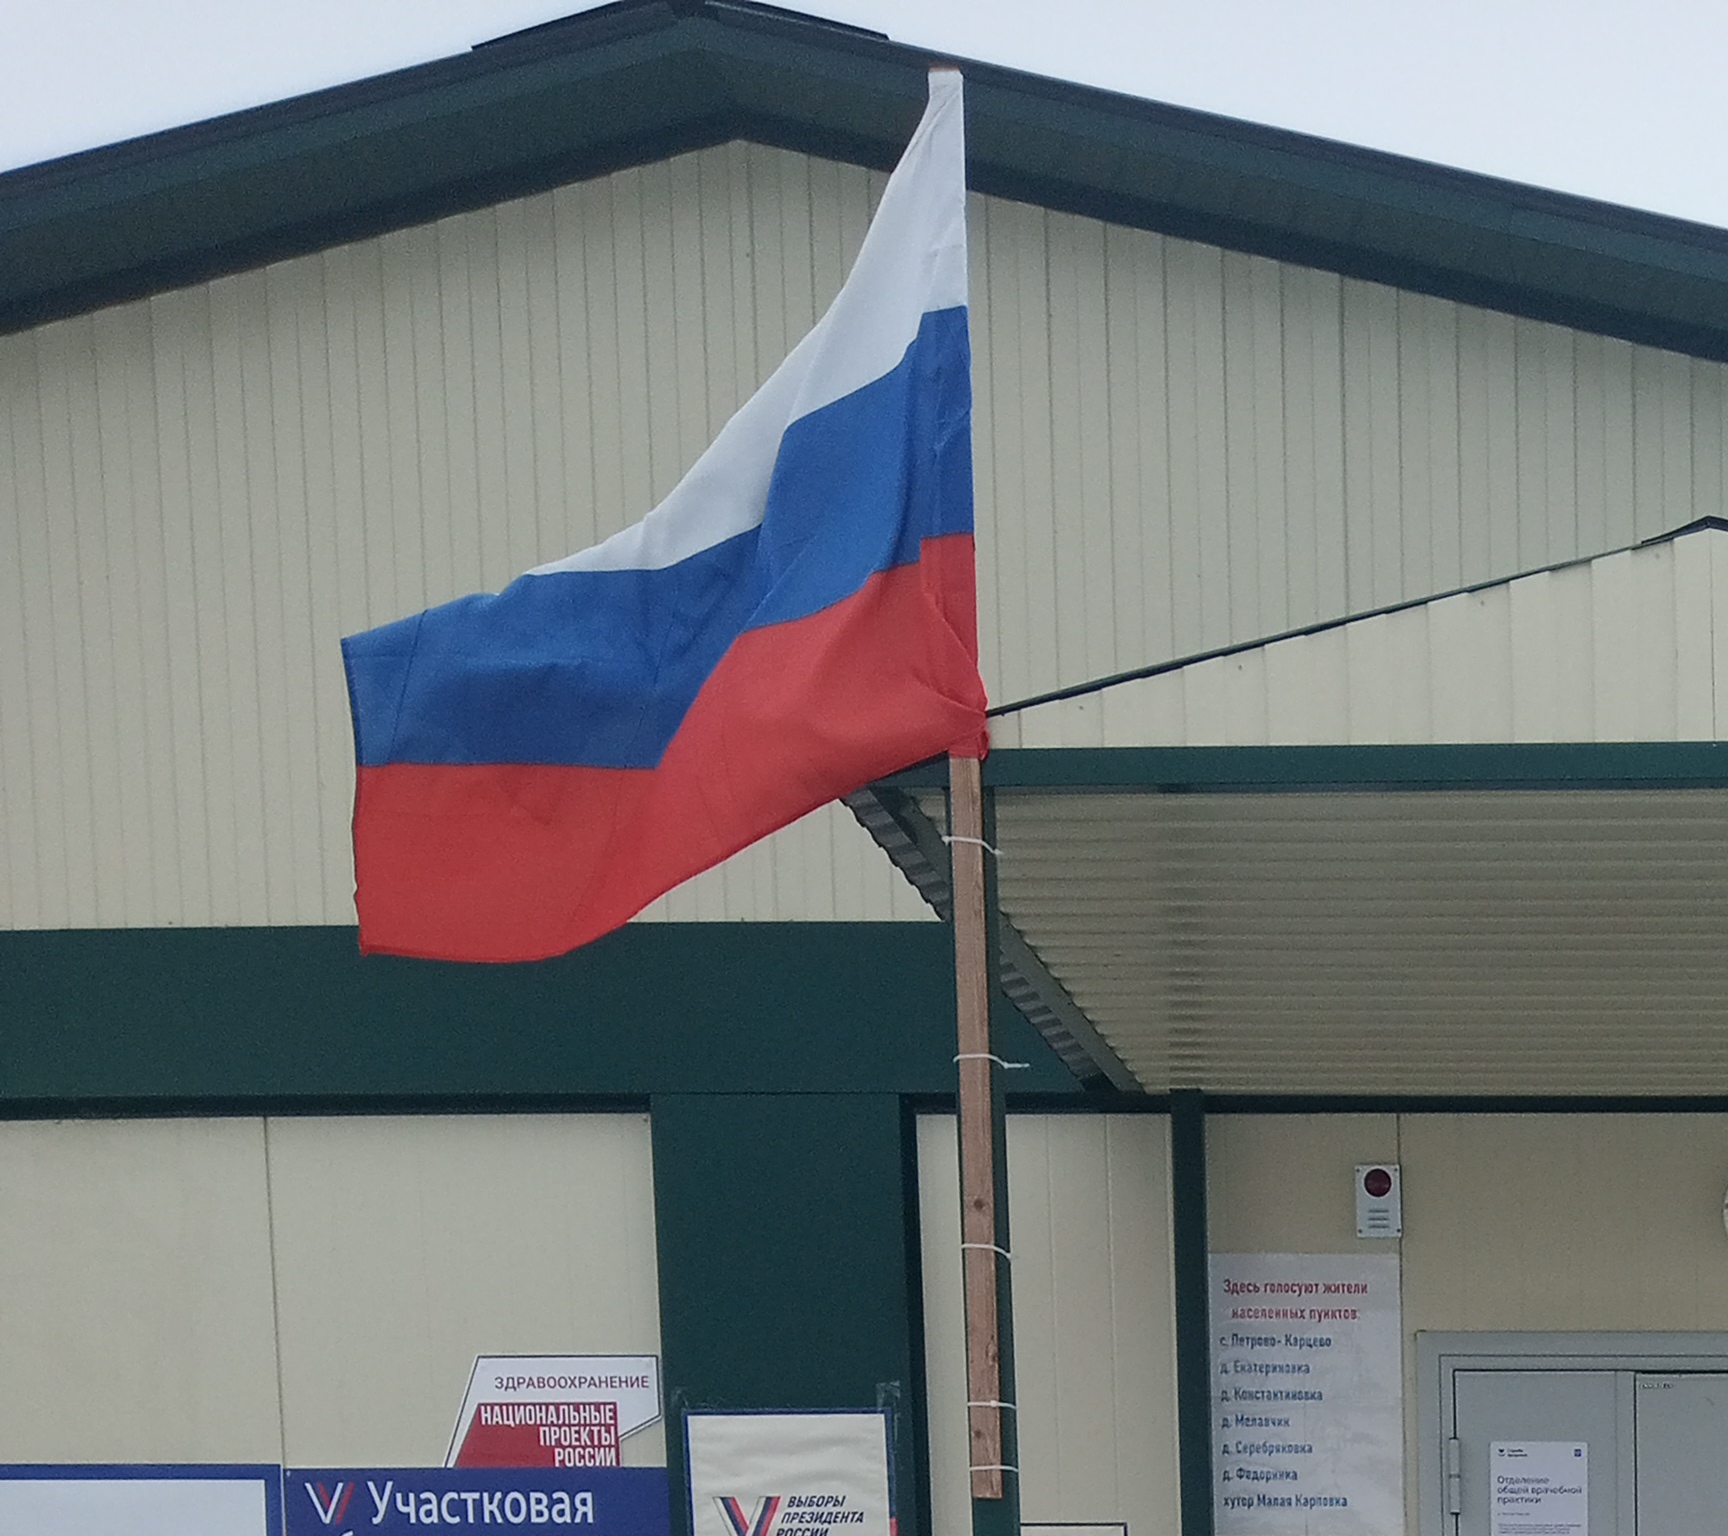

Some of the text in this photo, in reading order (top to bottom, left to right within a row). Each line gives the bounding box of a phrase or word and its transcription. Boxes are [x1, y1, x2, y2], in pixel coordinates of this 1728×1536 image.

[1223, 1278, 1368, 1297] Здесь голосуют жители
[1232, 1308, 1306, 1320] населенных
[494, 1375, 649, 1391] ЗДРАВООХРАНЕНИЕ
[1234, 1387, 1323, 1401] Константиновка
[480, 1404, 615, 1427] НАЦИОНАЛЬНЫЕ
[539, 1426, 616, 1446] ПРОЕКТЫ
[554, 1447, 617, 1467] РОССИИ
[366, 1480, 595, 1525] Участковая
[787, 1495, 846, 1508] ВЫБОРЫ
[1257, 1494, 1292, 1507] Малая
[781, 1511, 865, 1525] ПРЕЗИДЕНТА
